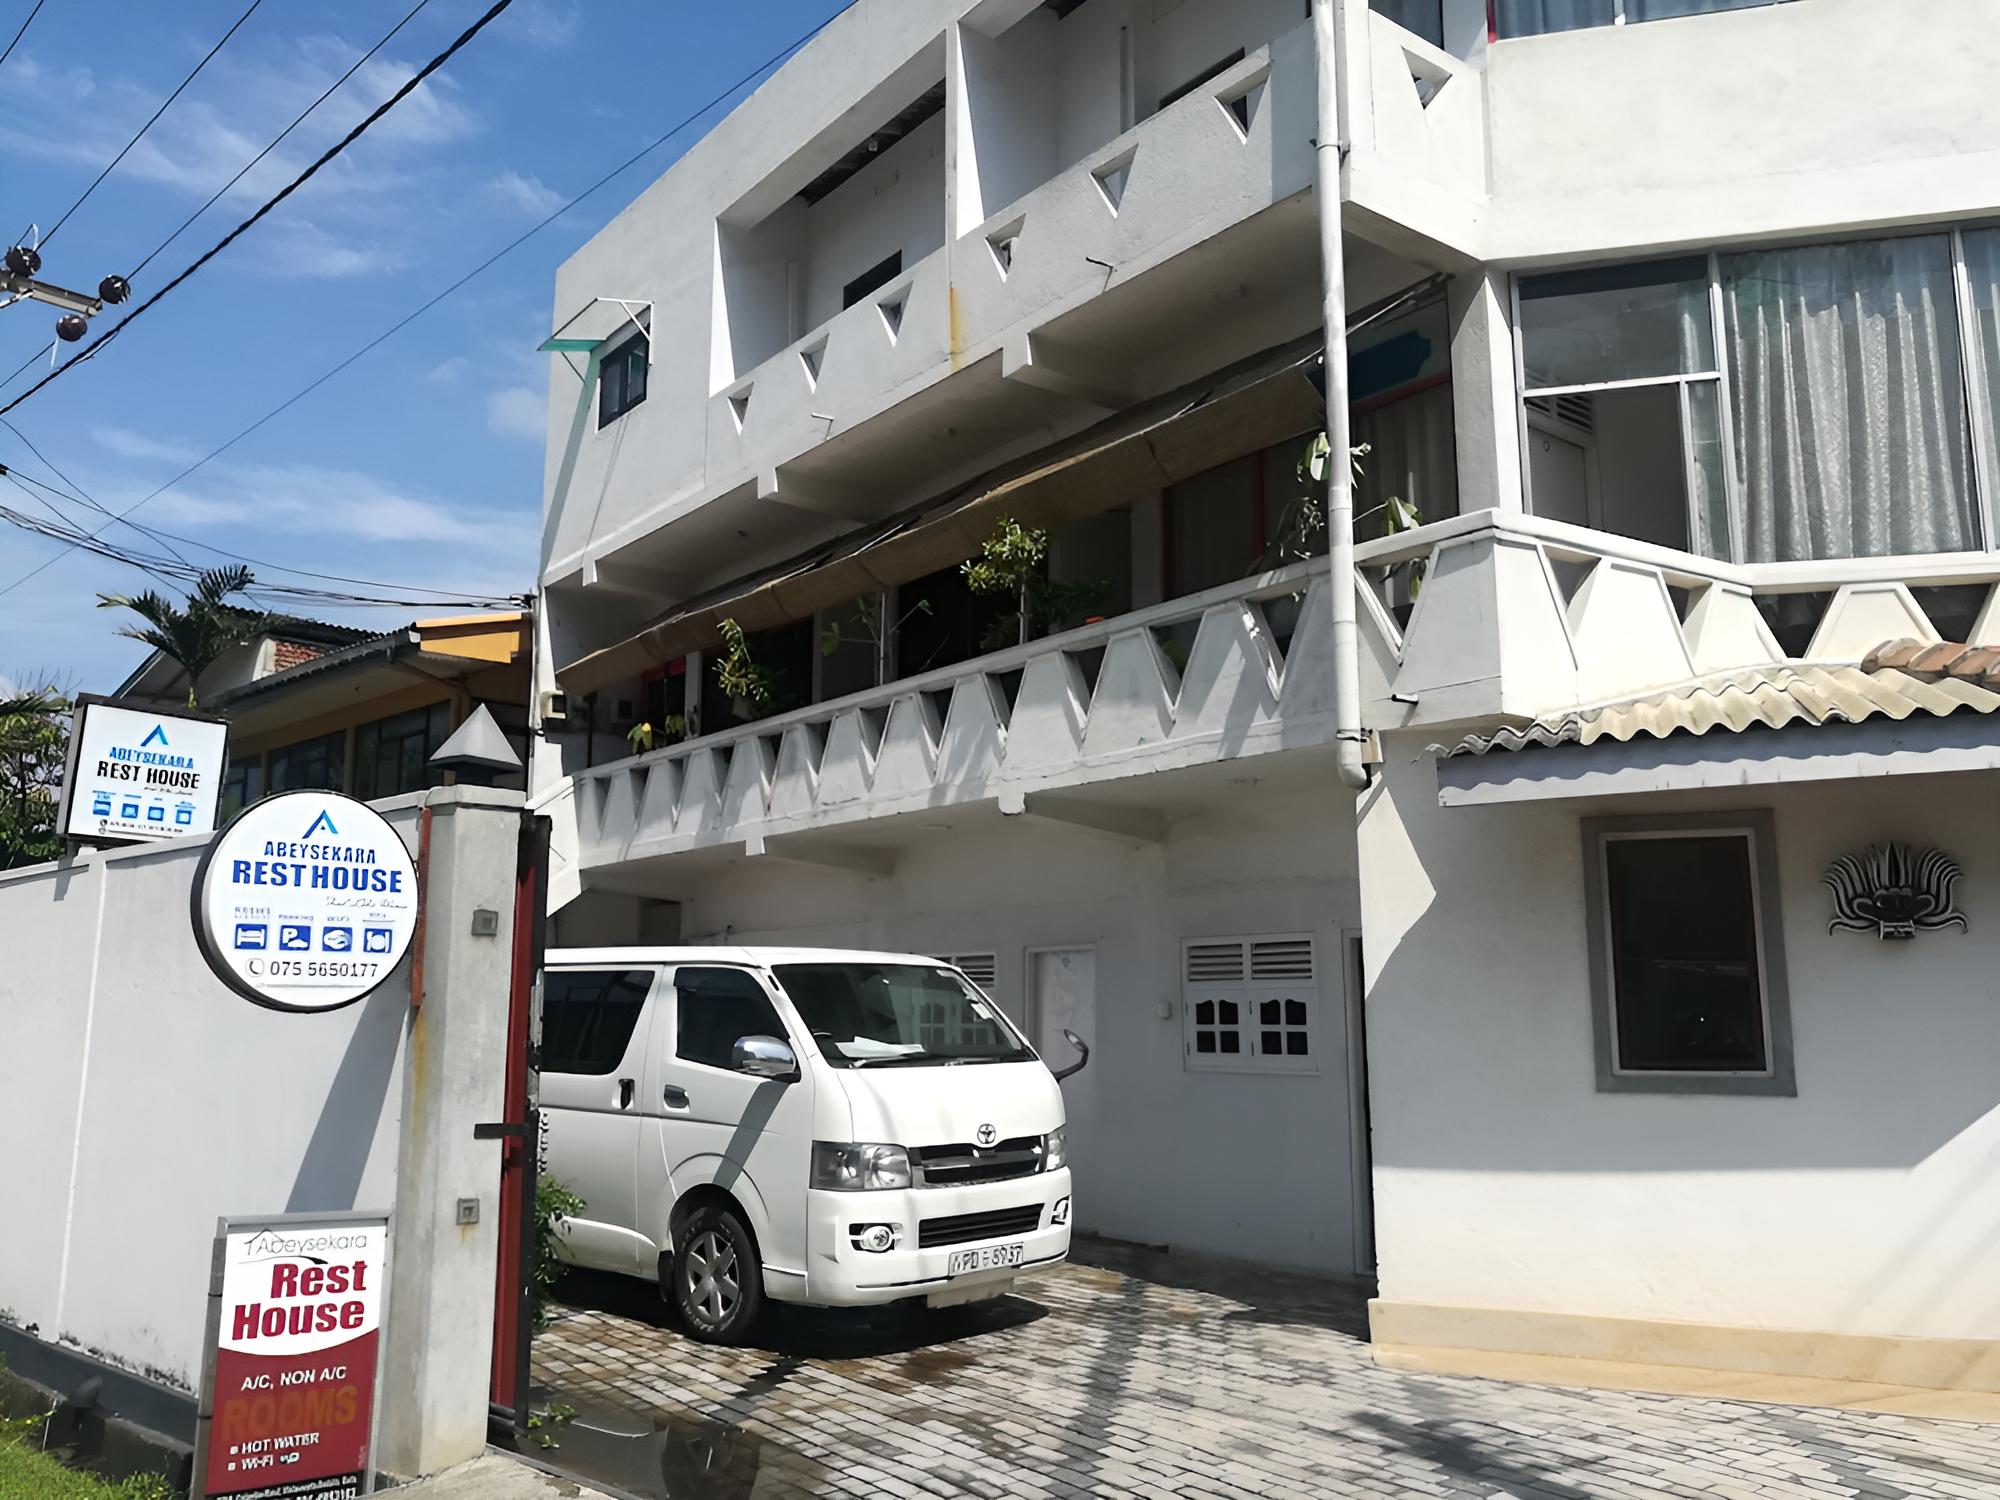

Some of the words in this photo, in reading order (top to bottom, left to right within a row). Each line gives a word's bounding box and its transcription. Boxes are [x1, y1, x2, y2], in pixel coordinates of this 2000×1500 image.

[97, 760, 141, 781] REST
[146, 767, 201, 789] HOUSE
[264, 841, 376, 864] ABEYSEKARA
[232, 860, 307, 887] REST
[311, 865, 403, 893] HOUSE
[270, 961, 302, 976] 075
[308, 963, 378, 977] 5650177
[270, 1260, 368, 1299] Rest
[232, 1300, 365, 1341] House
[280, 1369, 316, 1386] NON
[320, 1366, 347, 1381] A/C
[223, 1385, 358, 1441] ROOMS
[241, 1439, 271, 1454] HOT
[274, 1432, 320, 1449] WATER
